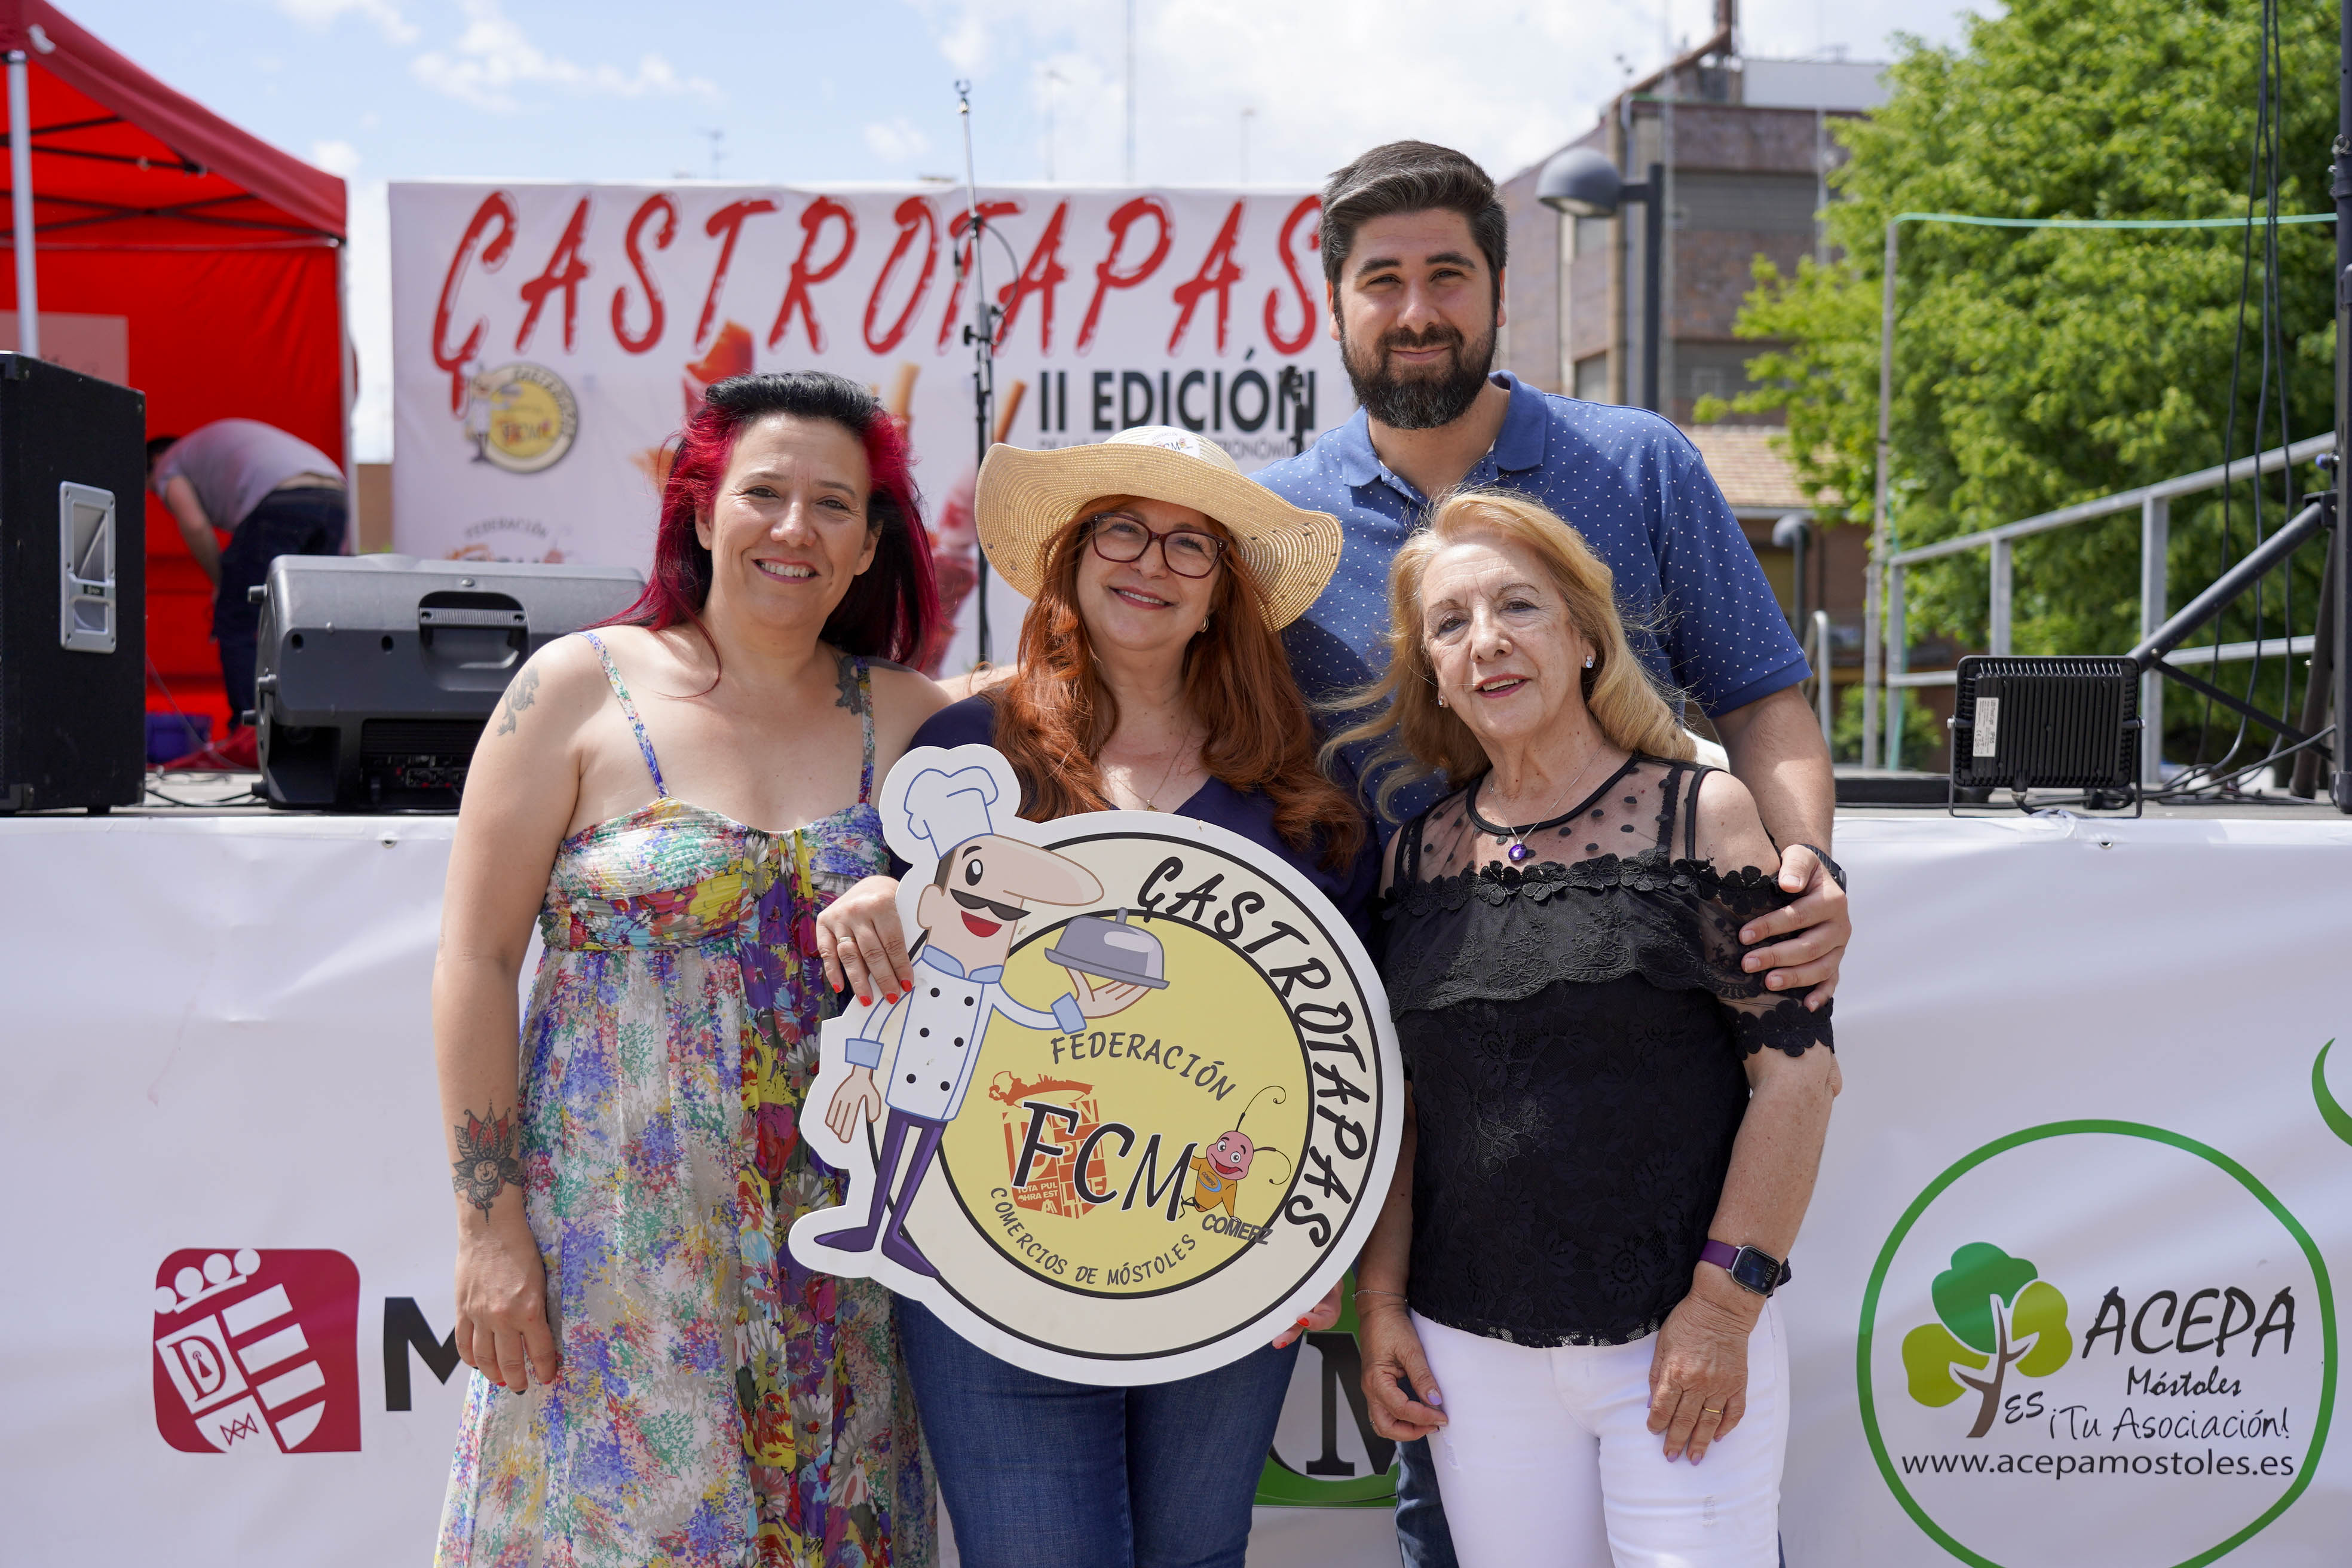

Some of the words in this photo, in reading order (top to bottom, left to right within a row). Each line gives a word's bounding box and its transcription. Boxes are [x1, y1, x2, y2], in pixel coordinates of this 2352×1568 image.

[1040, 371, 1067, 432] II
[1093, 348, 1315, 432] EDICIÓN
[1051, 1031, 1236, 1101] FEDERACIÓN
[1013, 1101, 1198, 1221] FCM
[1043, 1190, 1058, 1198] EST
[991, 1187, 1068, 1275] COMERCIOS
[1076, 1266, 1098, 1284] DE
[1107, 1233, 1197, 1286] MÓSTOLES
[1201, 1214, 1273, 1245] COMERZ
[1764, 1264, 1776, 1282] 13:09
[2082, 1286, 2295, 1358] ACEPA
[2127, 1365, 2241, 1396] Móstoles
[2005, 1391, 2044, 1423] ES
[2112, 1407, 2289, 1441] Asociación!
[1901, 1448, 2295, 1480] www.acepamostoles.es
